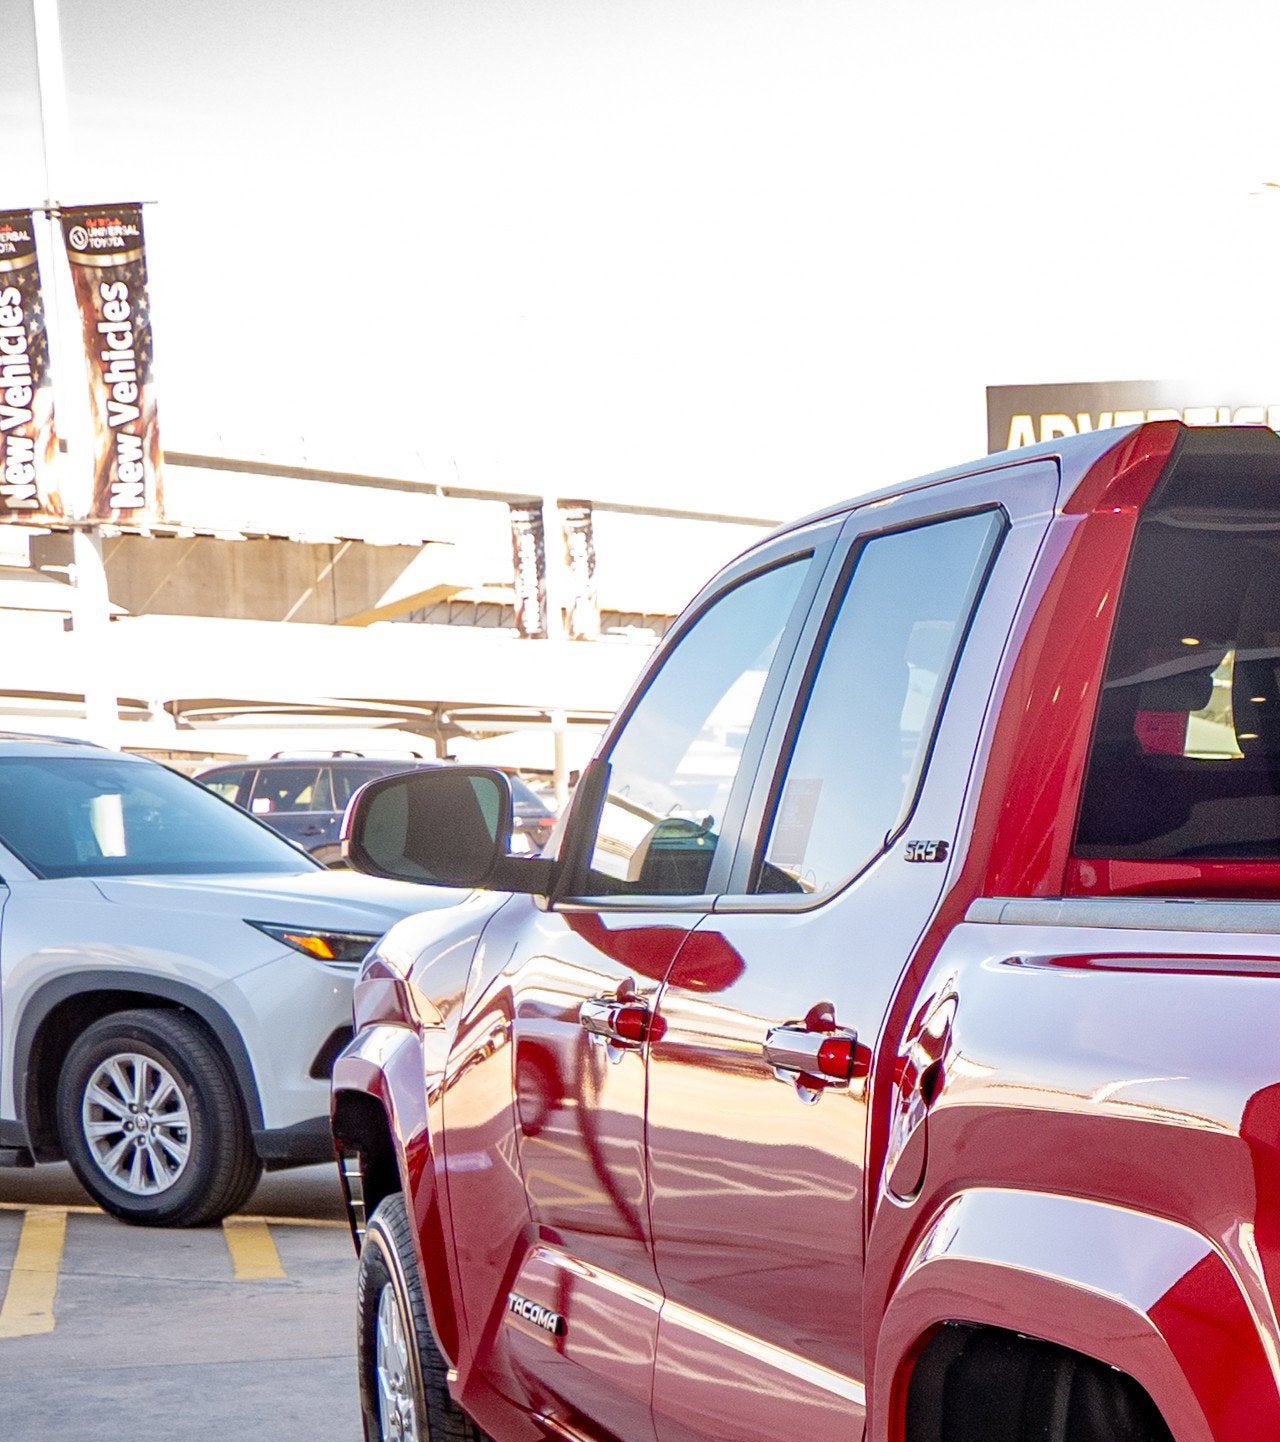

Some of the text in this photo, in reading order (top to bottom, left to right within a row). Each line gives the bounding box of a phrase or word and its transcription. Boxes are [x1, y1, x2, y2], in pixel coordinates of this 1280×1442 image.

[89, 237, 125, 248] TOYOTA
[0, 286, 39, 509] New Vehicles
[98, 281, 145, 508] New Vehicles
[508, 1292, 558, 1333] TACOMA
